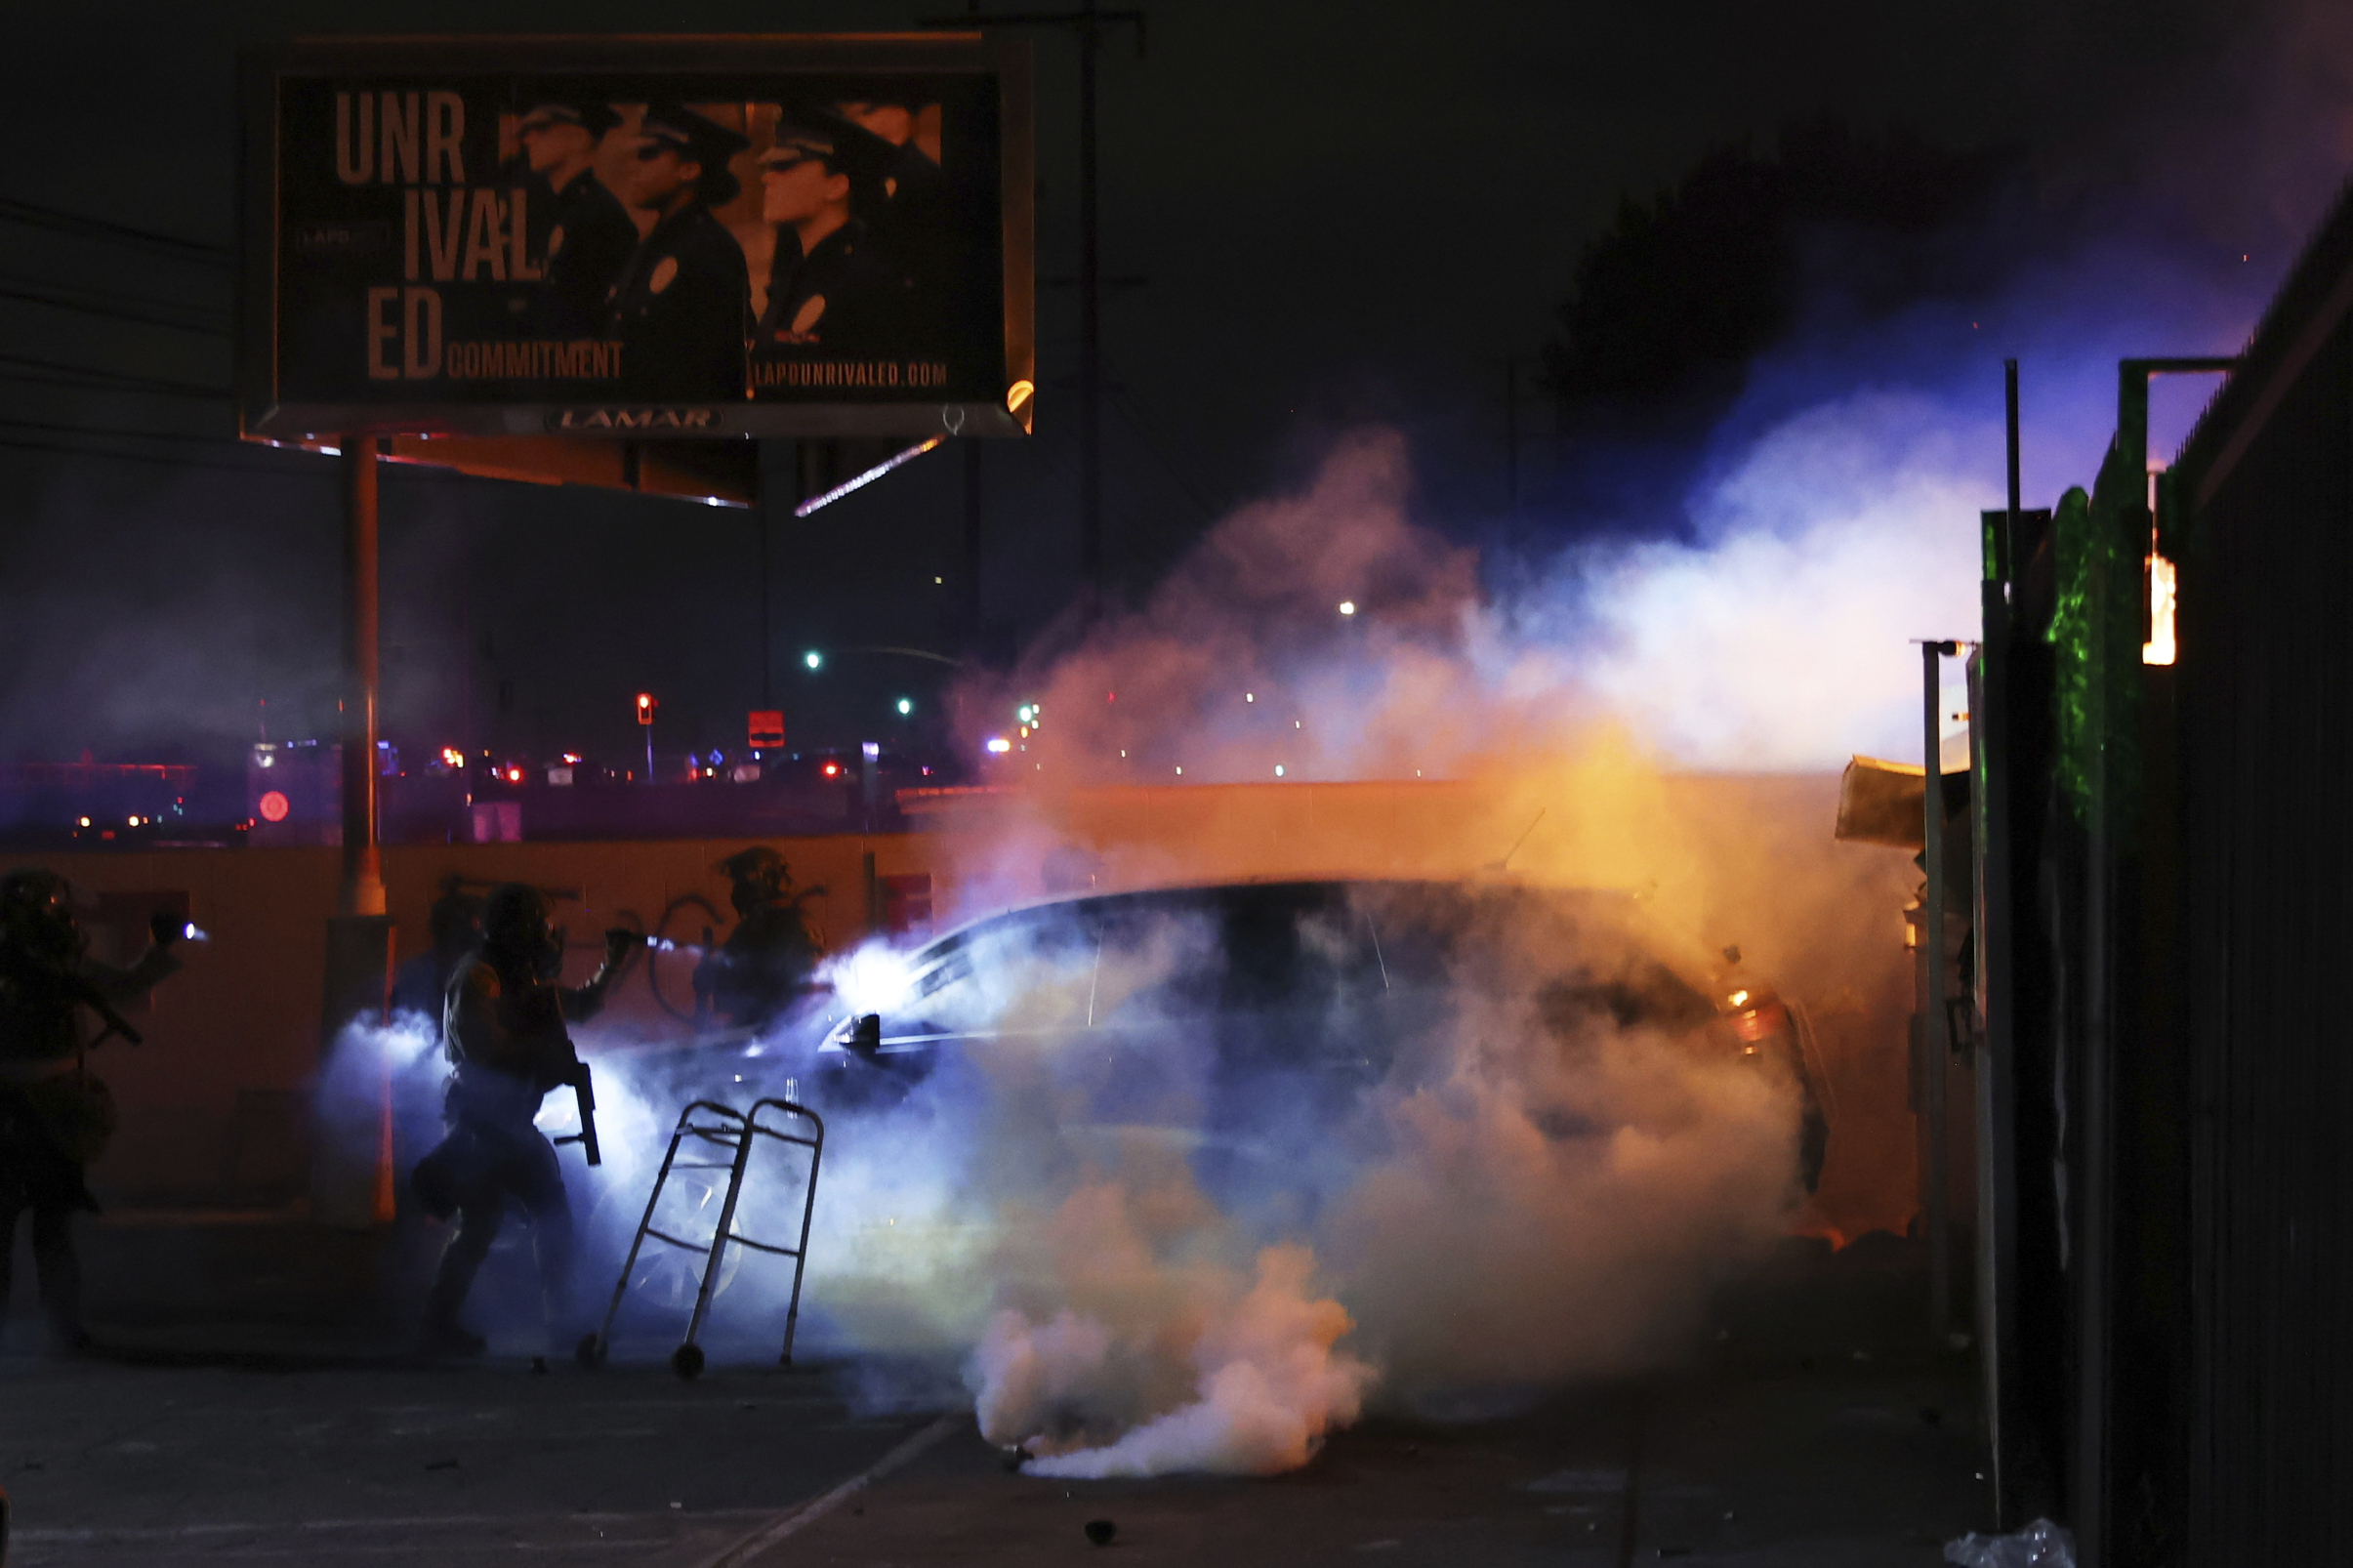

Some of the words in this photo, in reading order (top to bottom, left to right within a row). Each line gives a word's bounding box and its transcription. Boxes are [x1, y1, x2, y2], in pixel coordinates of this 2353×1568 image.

[336, 91, 466, 186] UNR
[403, 187, 544, 281] IVAL
[367, 286, 442, 380] ED
[447, 341, 624, 379] COMMITMENT
[559, 408, 712, 429] LAMAR
